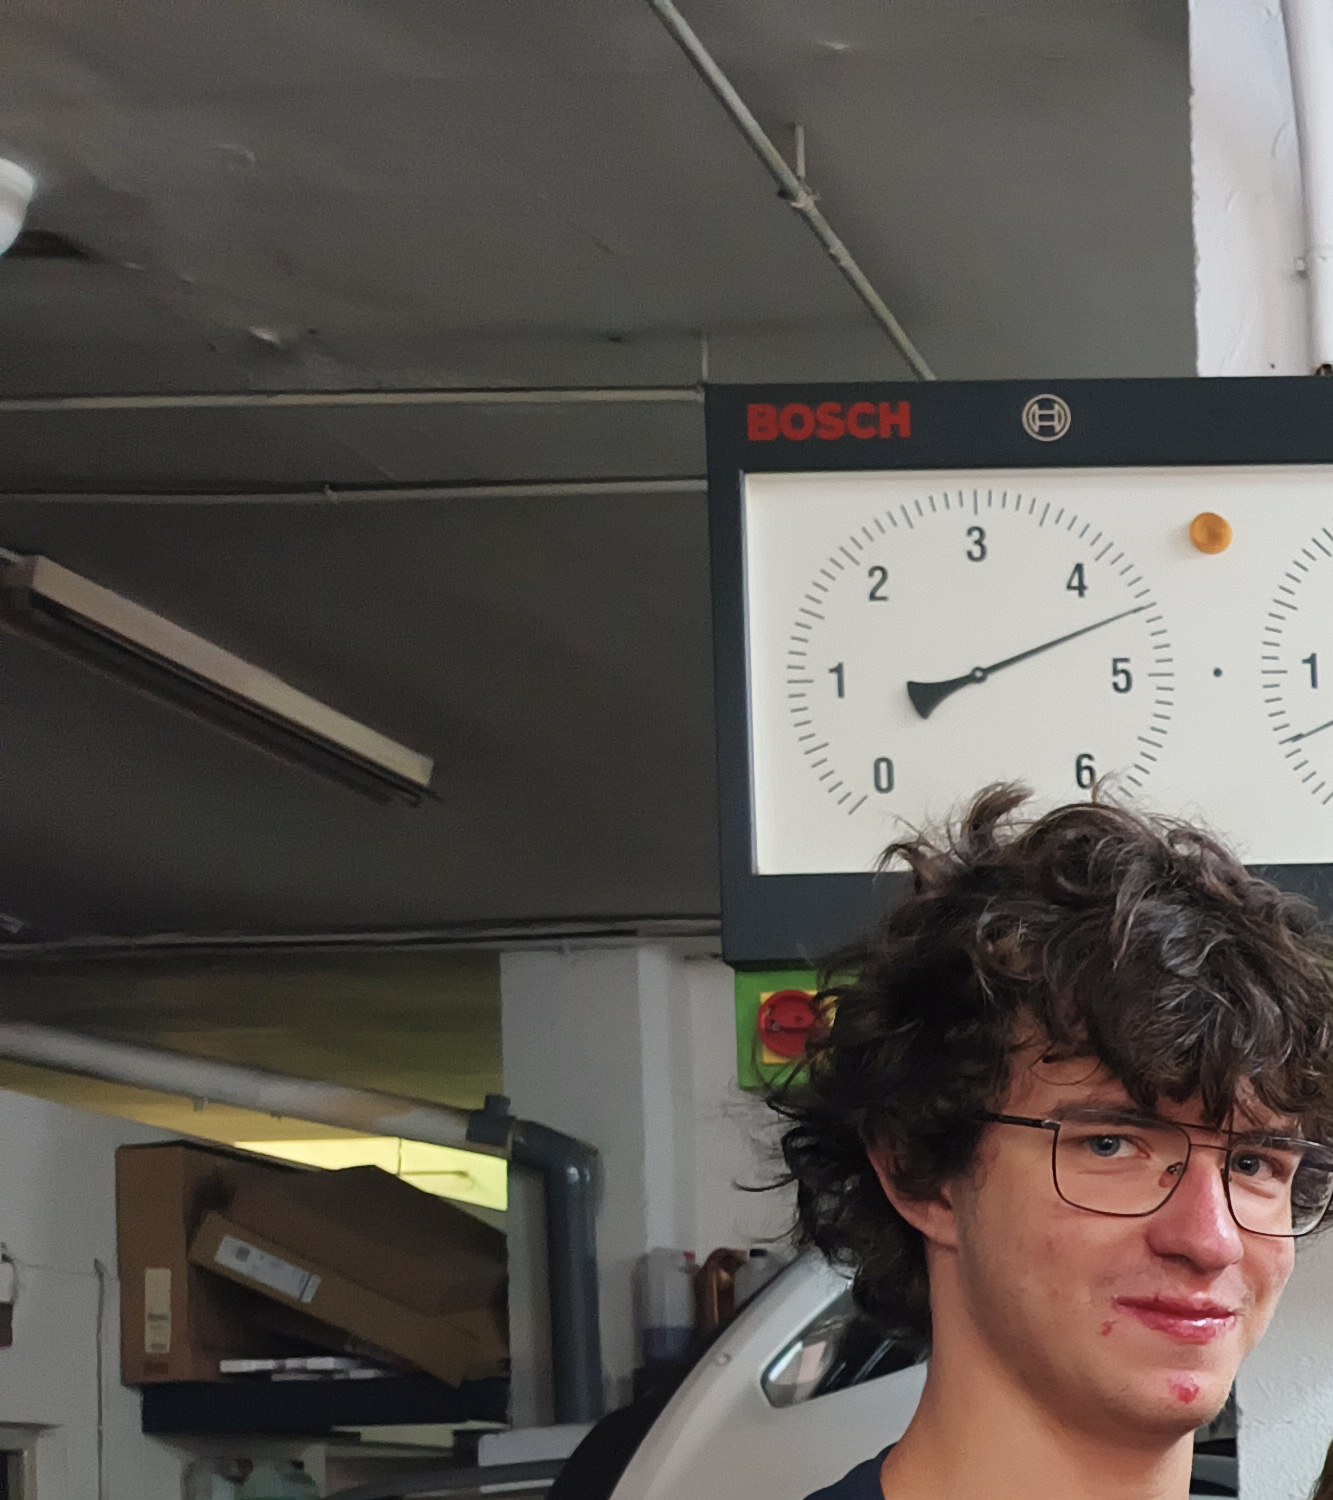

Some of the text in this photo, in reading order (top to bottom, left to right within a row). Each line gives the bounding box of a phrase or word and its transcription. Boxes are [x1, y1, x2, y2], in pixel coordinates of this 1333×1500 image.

[747, 402, 912, 440] BOSCH
[966, 525, 987, 562] 3
[868, 565, 888, 602] 2
[1066, 562, 1087, 598] 4
[828, 662, 845, 698] 1
[1112, 657, 1132, 694] 5
[1302, 653, 1318, 689] 1
[873, 757, 894, 794] 0
[1075, 753, 1096, 790] 6
